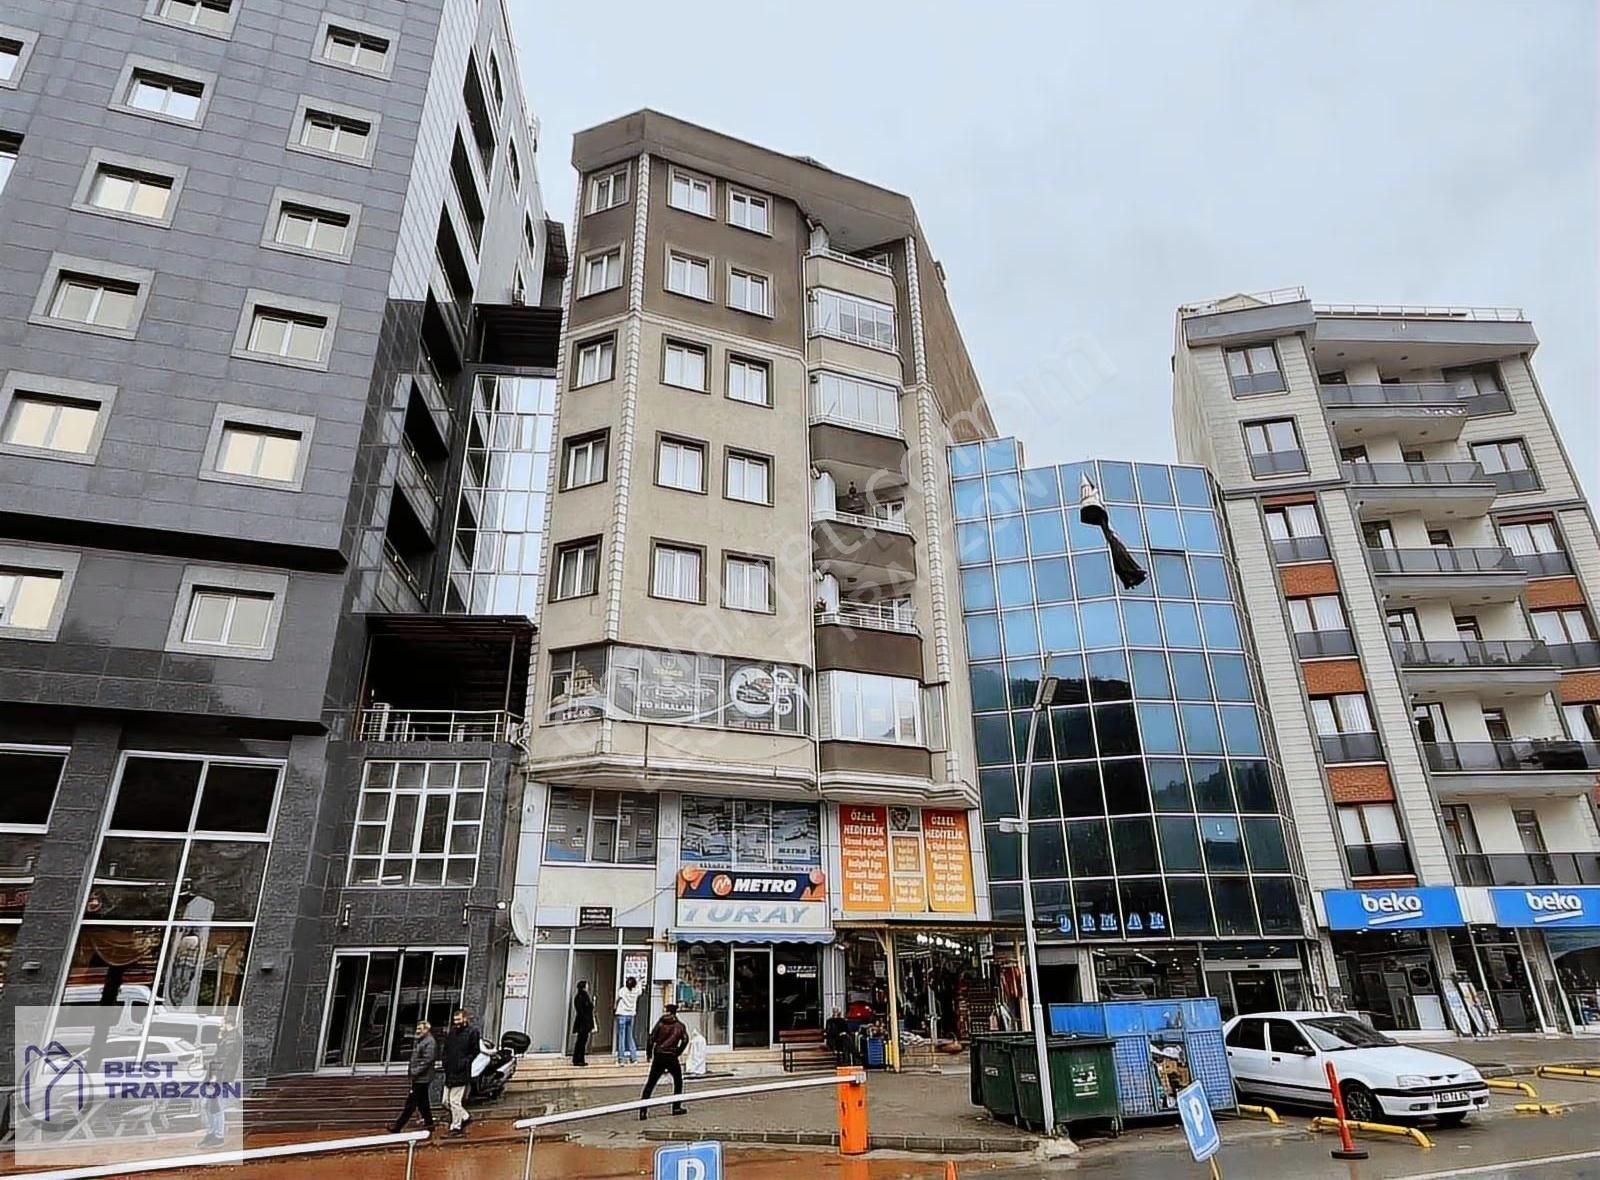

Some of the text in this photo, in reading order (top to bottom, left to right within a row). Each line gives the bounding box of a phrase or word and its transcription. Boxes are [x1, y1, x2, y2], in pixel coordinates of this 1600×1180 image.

[733, 877, 797, 893] METRO
[1361, 892, 1422, 912] beko
[1525, 891, 1582, 910] beko
[683, 904, 810, 924] TURAY
[1188, 1096, 1205, 1137] P
